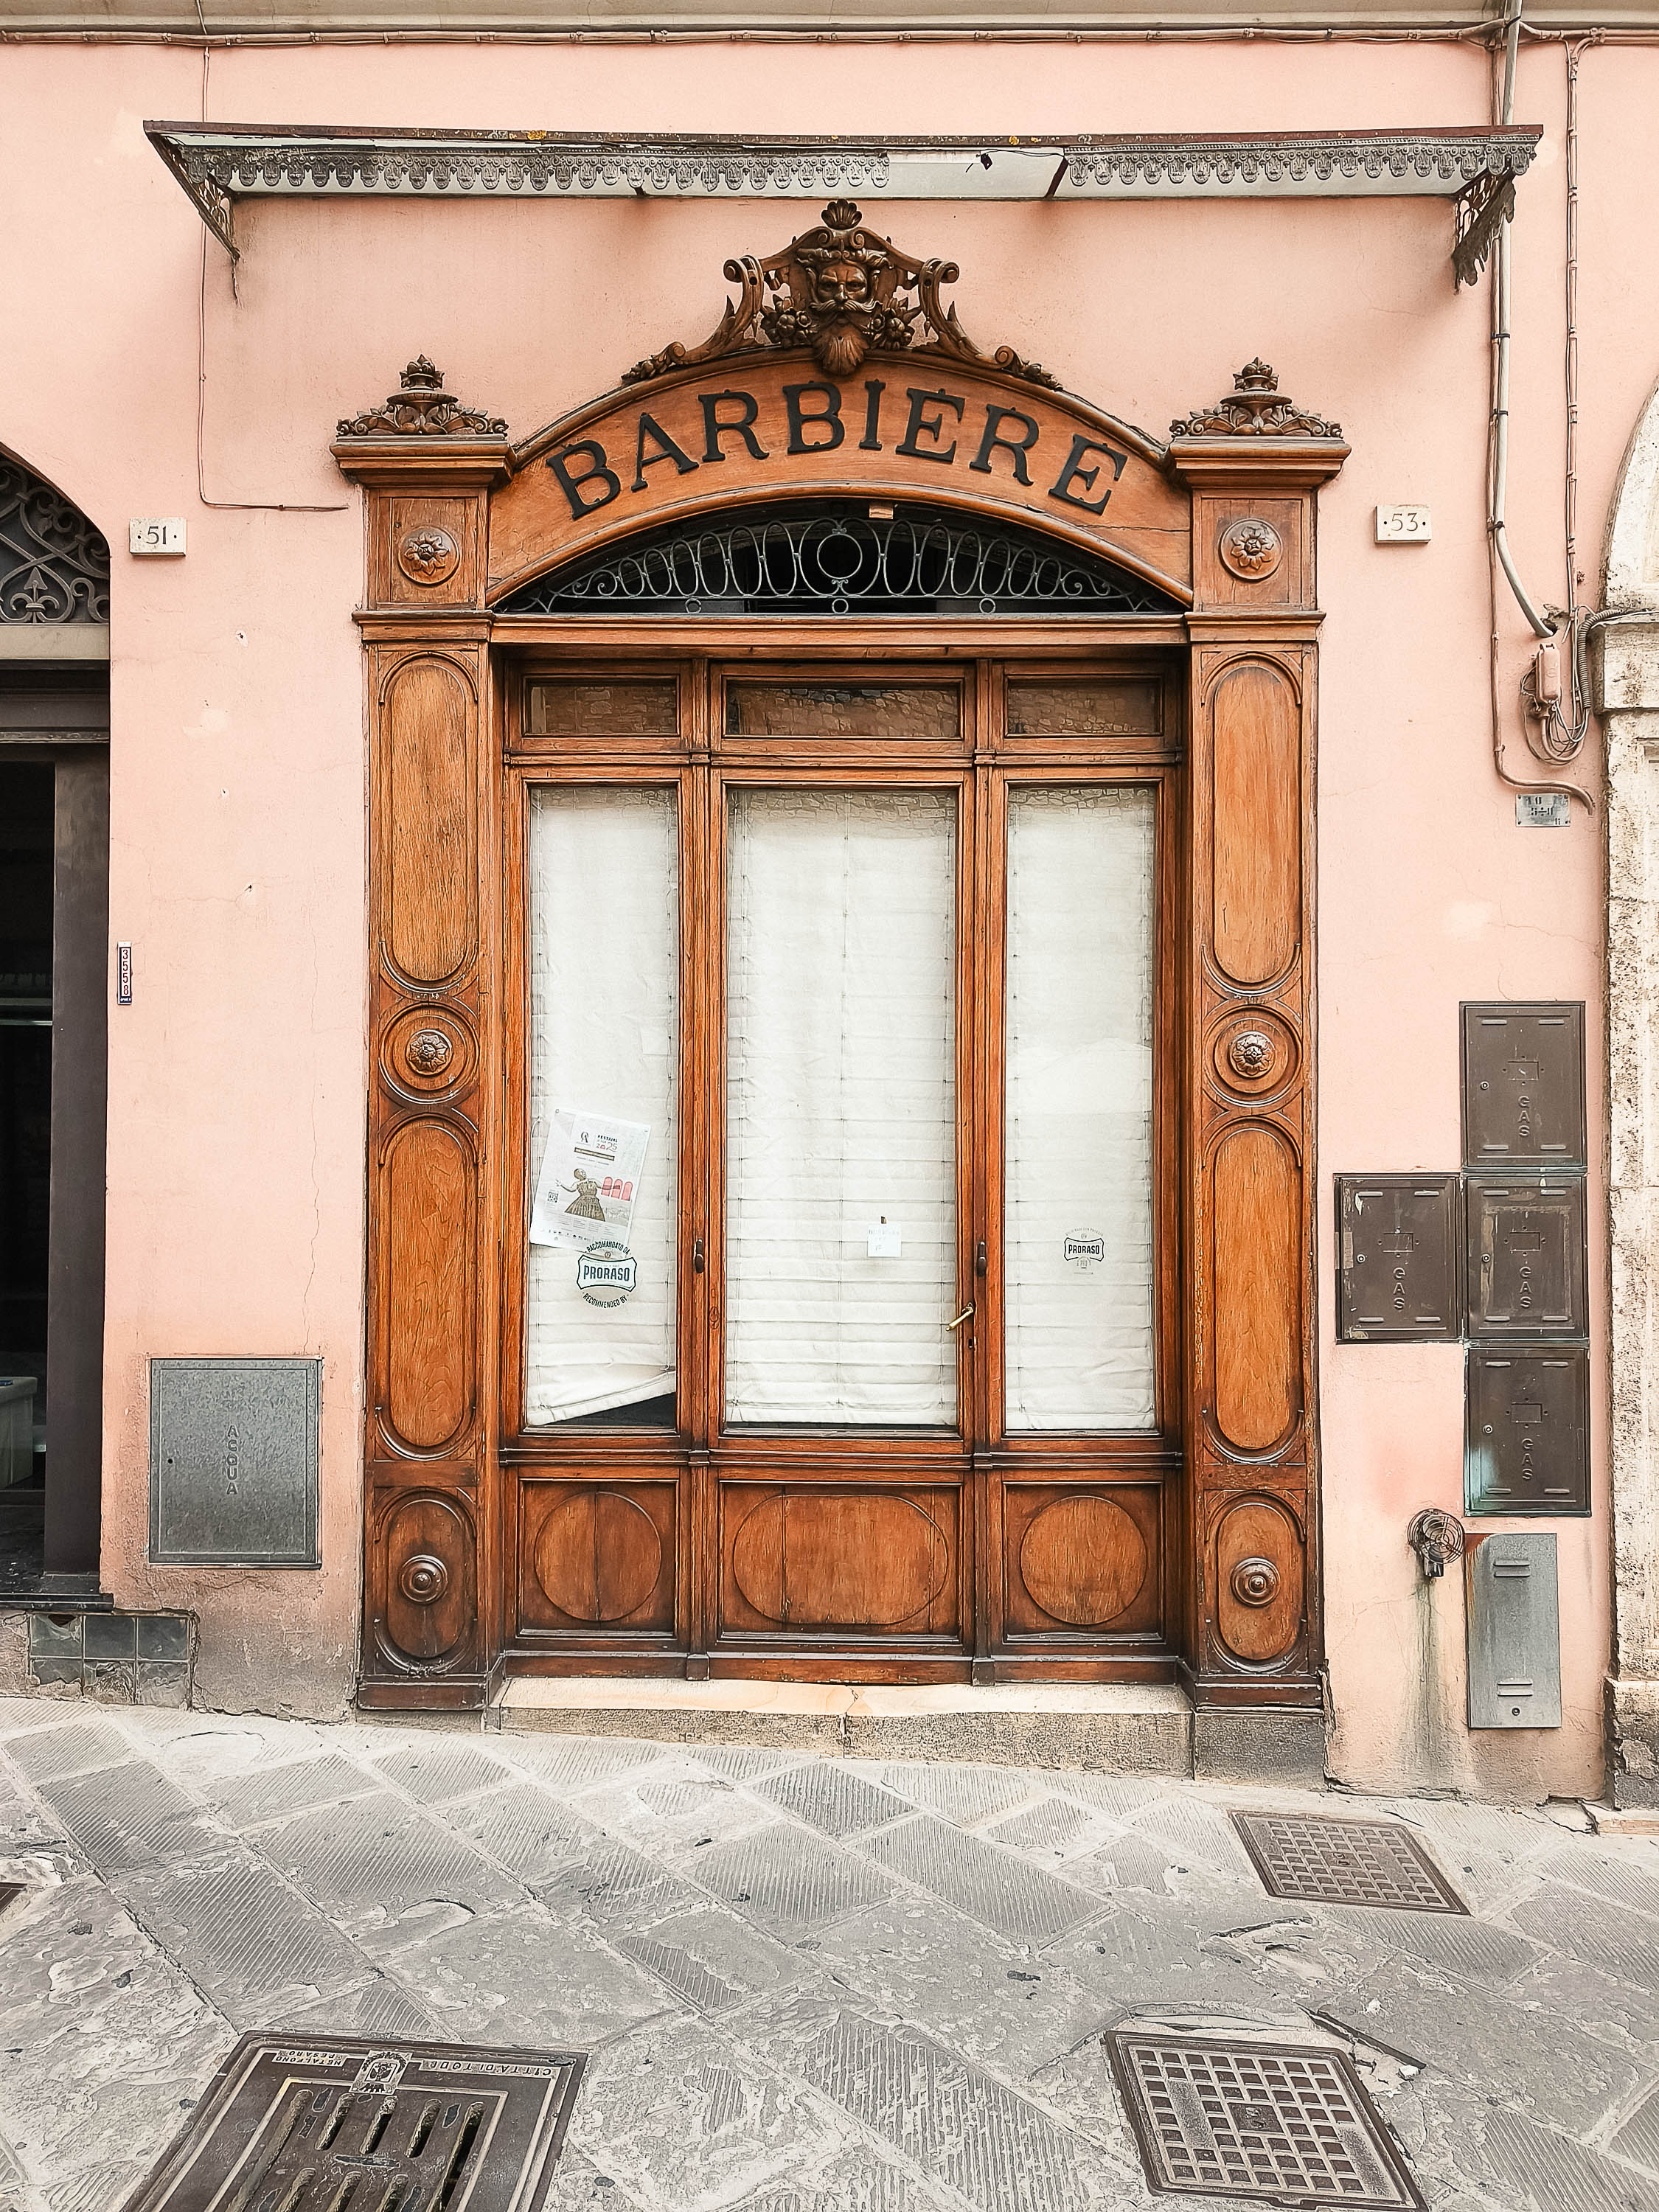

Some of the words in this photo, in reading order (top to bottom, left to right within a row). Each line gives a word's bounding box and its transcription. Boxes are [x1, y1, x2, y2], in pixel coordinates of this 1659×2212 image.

[546, 378, 1129, 521] BARBIERE
[1517, 1095, 1531, 1137] GAS
[586, 1240, 624, 1253] RACCOMANDATO
[623, 1247, 630, 1255] DA
[1068, 1244, 1100, 1255] PRORASO
[583, 1265, 630, 1281] PRORASO
[1519, 1265, 1533, 1310] GAS
[582, 1293, 620, 1309] RECOMMENDED
[621, 1294, 628, 1304] BY
[1393, 1267, 1406, 1311] GAS
[226, 1425, 240, 1495] ACQUA
[1521, 1438, 1534, 1481] GAS
[275, 2056, 342, 2066] METALFOND
[288, 2051, 335, 2059] PESARO
